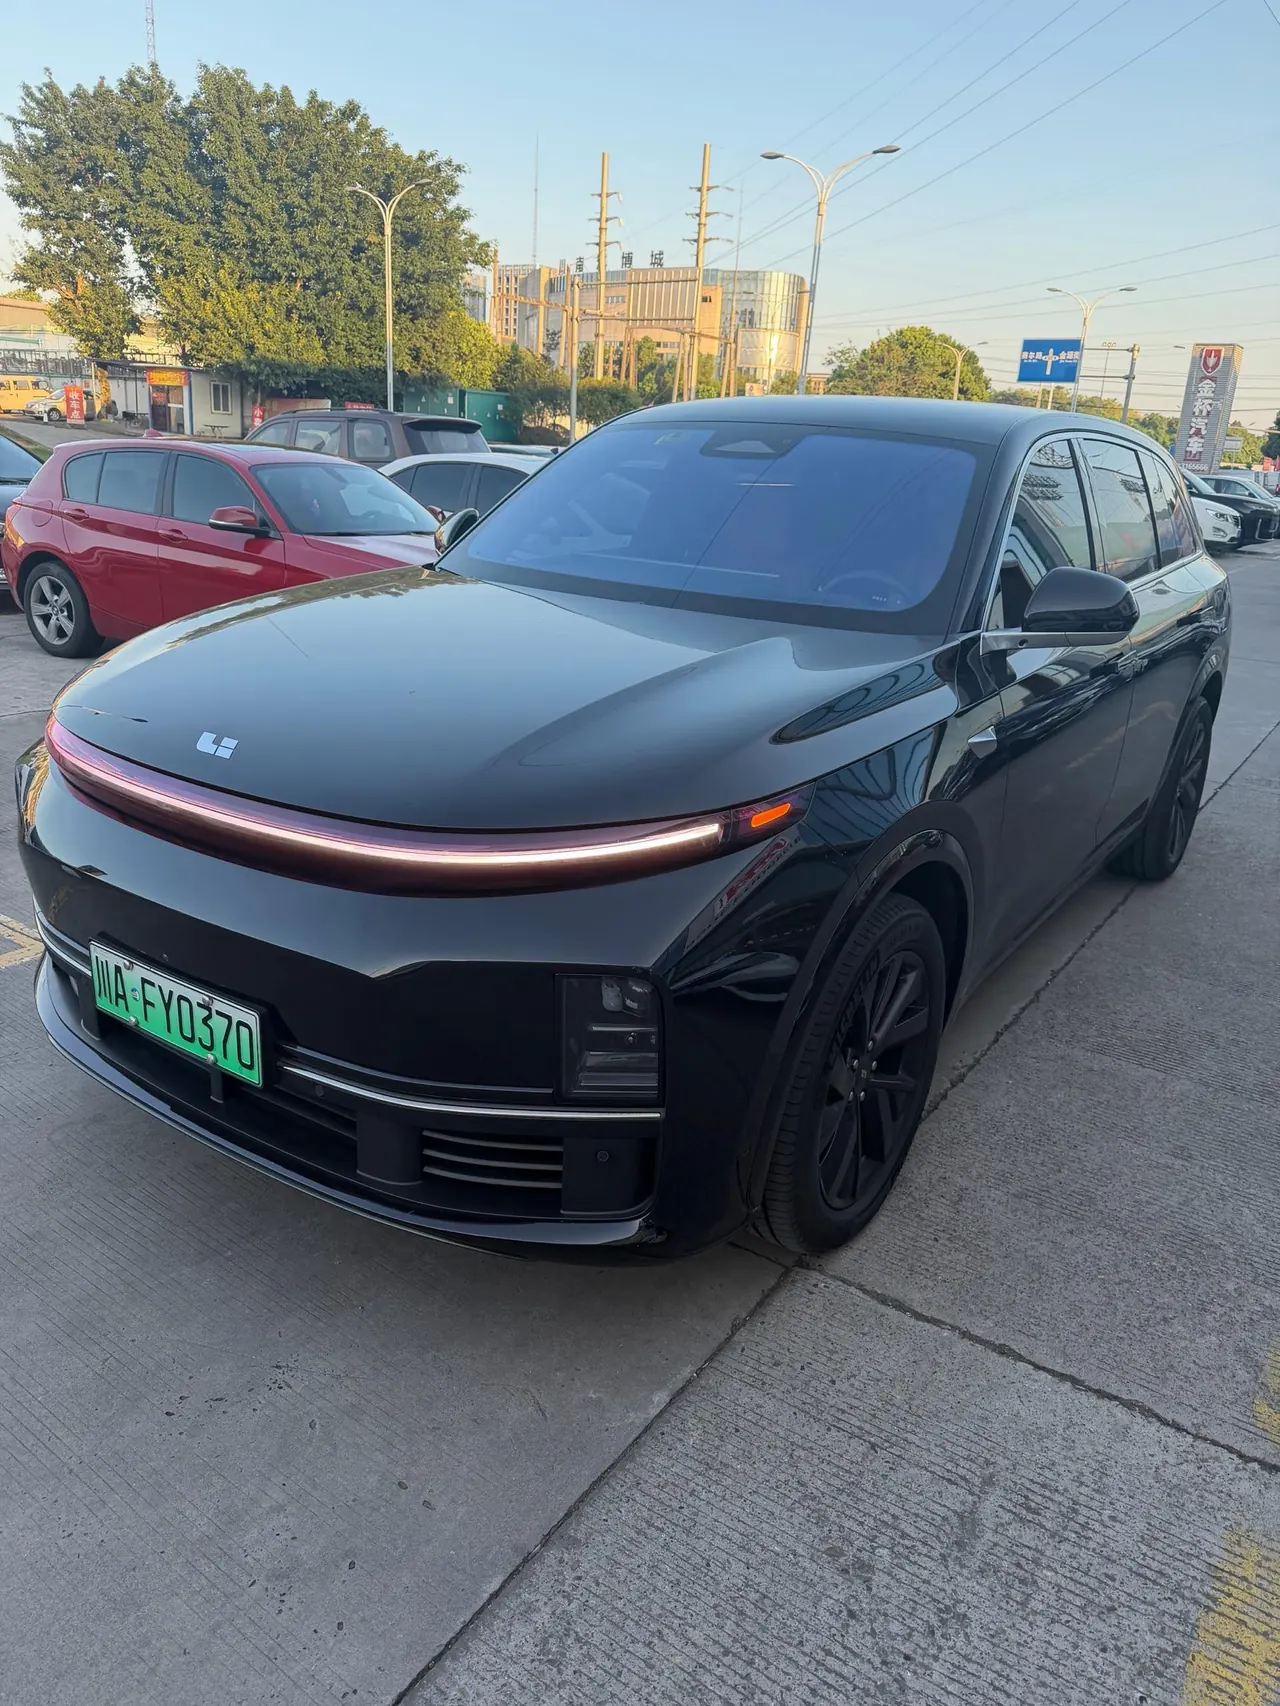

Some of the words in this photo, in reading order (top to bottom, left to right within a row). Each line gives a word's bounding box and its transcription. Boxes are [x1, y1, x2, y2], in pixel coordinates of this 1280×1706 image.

[69, 390, 82, 419] 收车点
[1186, 379, 1217, 455] 金杯汽车
